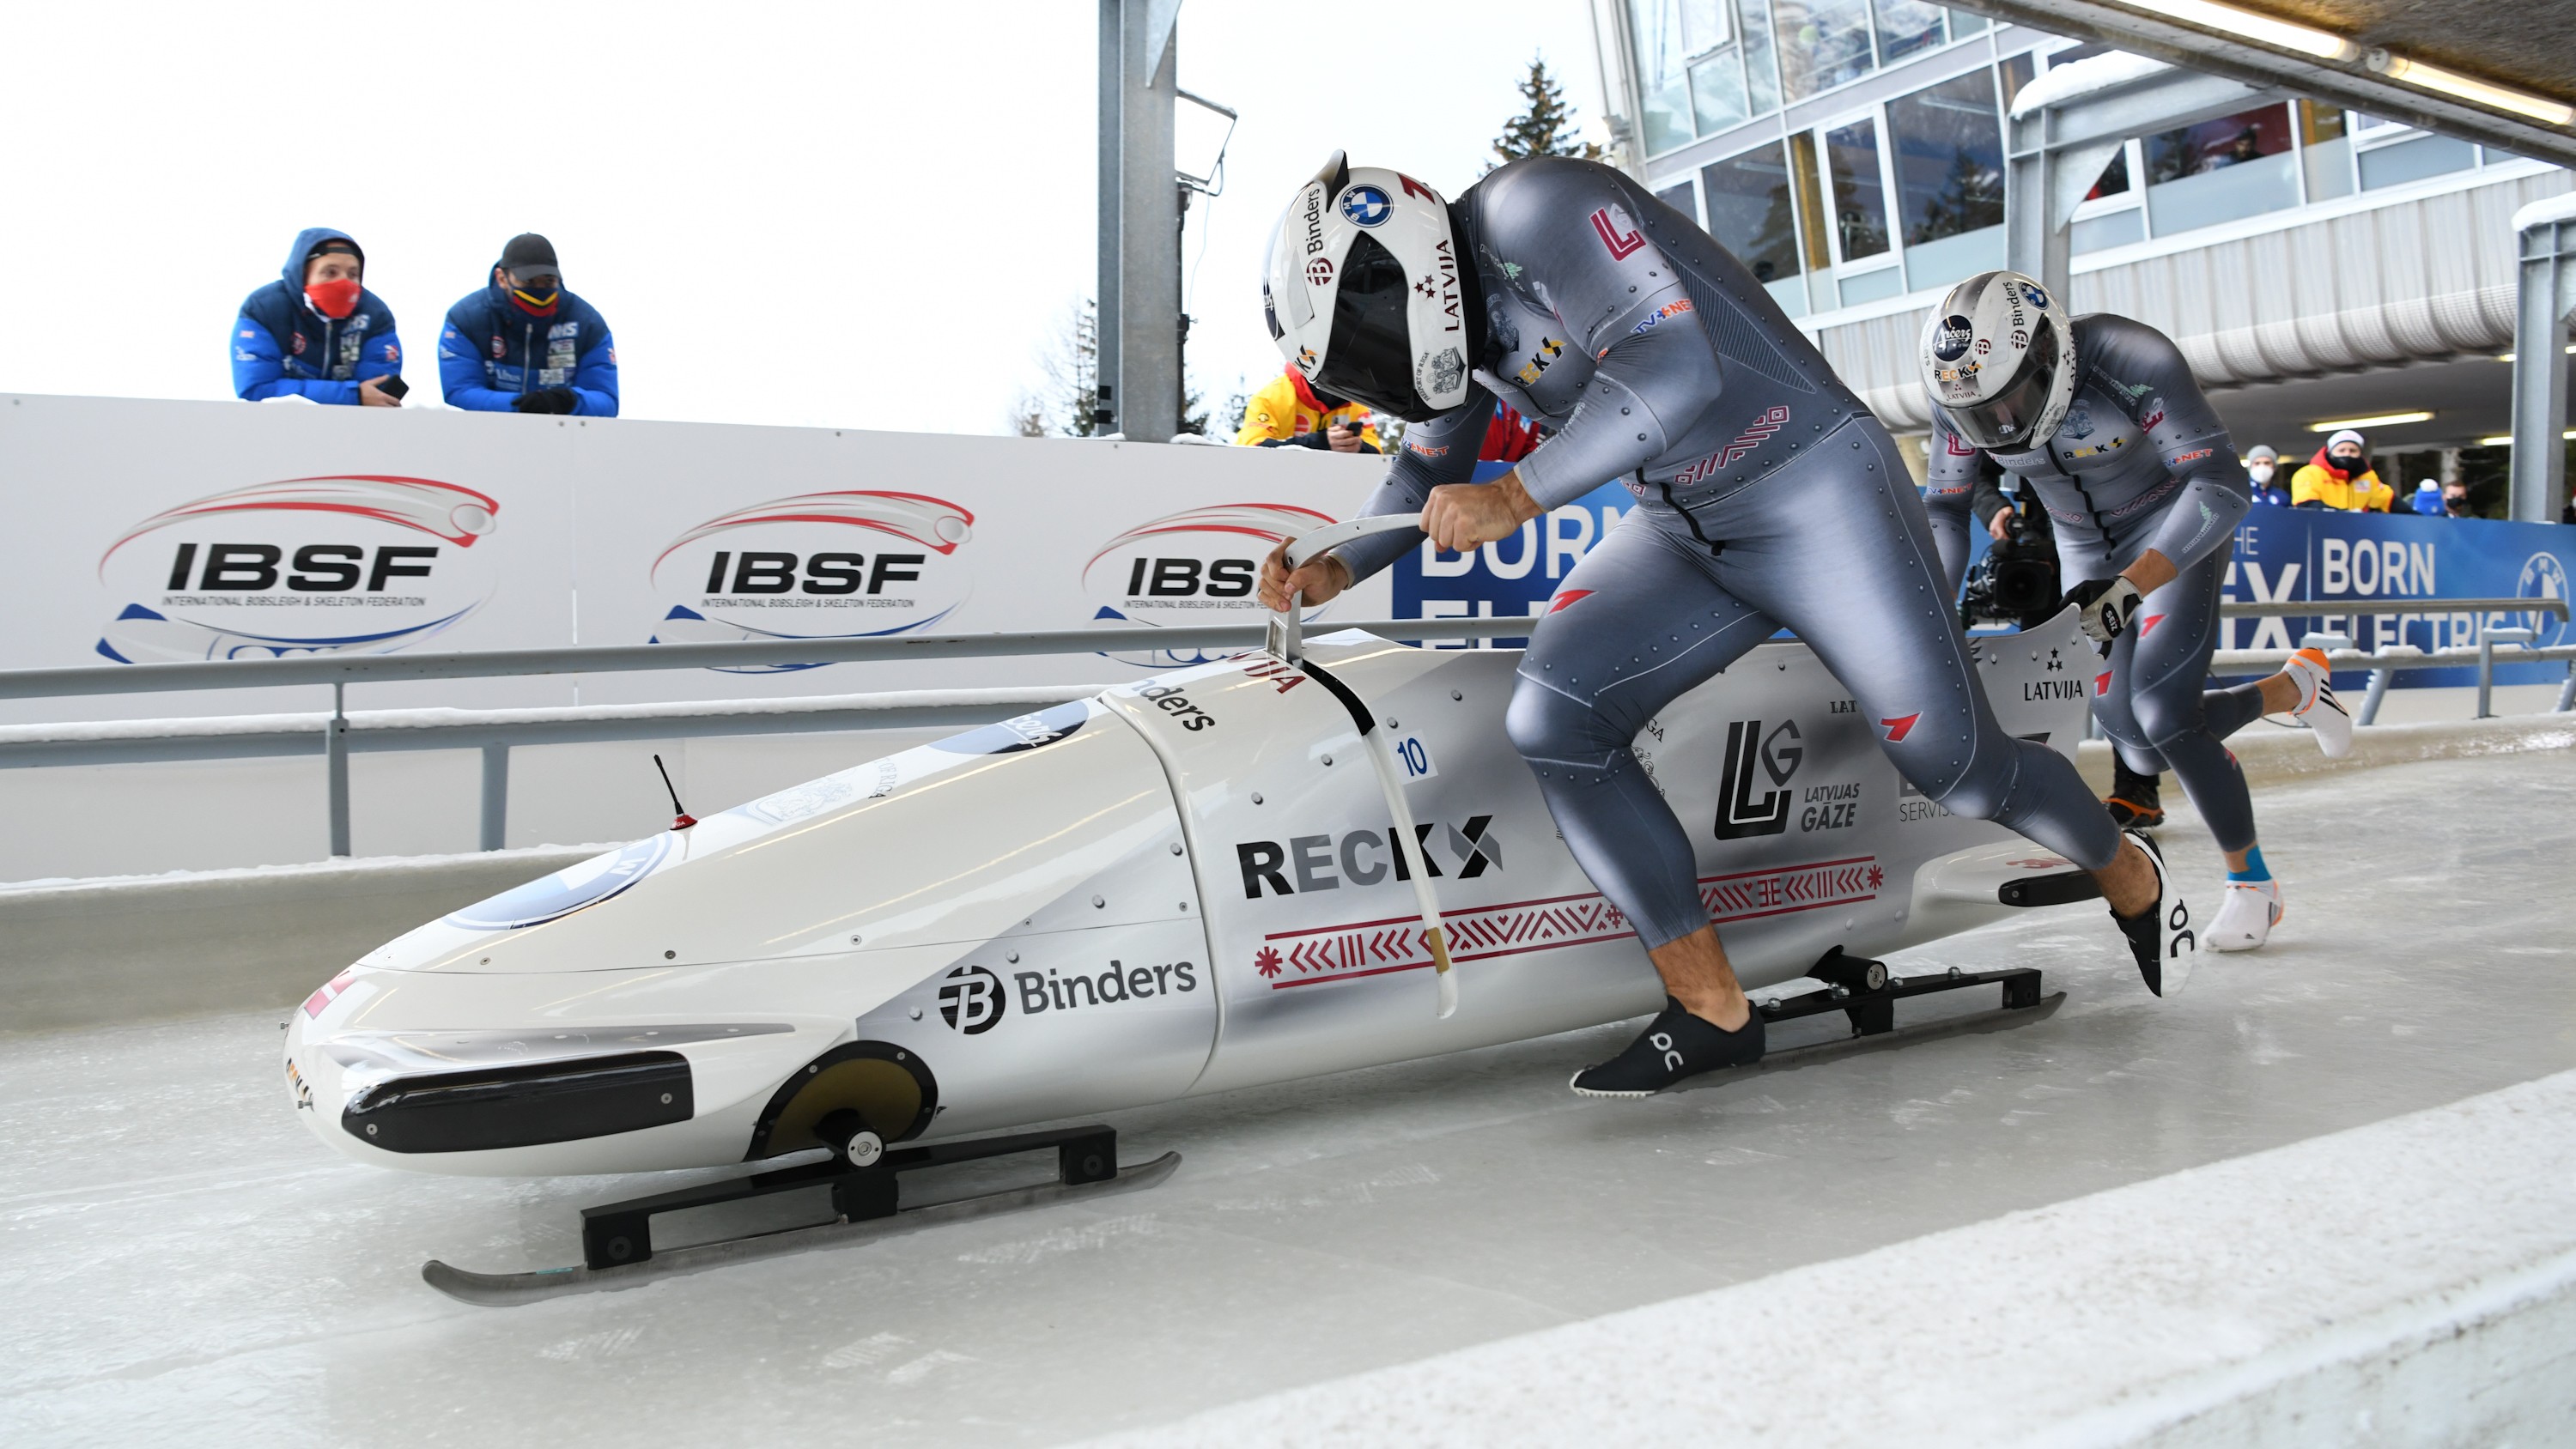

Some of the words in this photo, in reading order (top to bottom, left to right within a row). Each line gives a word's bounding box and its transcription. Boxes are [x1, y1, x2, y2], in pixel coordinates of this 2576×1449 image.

[1303, 188, 1323, 256] Binders
[1437, 239, 1460, 332] LATVIJA
[2002, 282, 2025, 326] Binders
[1947, 391, 1977, 400] LATVIJA
[167, 543, 439, 591] IBSF
[706, 551, 926, 594] IBSF
[1127, 558, 1261, 597] IBS
[2323, 538, 2435, 596] BORN
[162, 597, 242, 607] INTERNATIONAL
[246, 597, 301, 607] BOBSLEIGH
[304, 597, 311, 607] &
[314, 597, 364, 607] SKELETON
[367, 597, 427, 607] FEDERATION
[701, 598, 767, 608] INTERNATIONAL
[769, 598, 815, 608] BOBSLEIGH
[823, 598, 865, 608] SKELETON
[866, 598, 914, 609] FEDERATION
[1124, 600, 1176, 609] INTERNATIONAL
[1178, 600, 1216, 609] BOBSLEIGH
[1223, 600, 1256, 609] SKELETON
[2024, 680, 2083, 701] LATVIJA
[1397, 737, 1428, 777] 10
[1804, 782, 1861, 804] LATVIJAS
[1899, 802, 1955, 822] SERVI
[1801, 802, 1857, 833] GĀZE
[1014, 960, 1197, 1015] Binders
